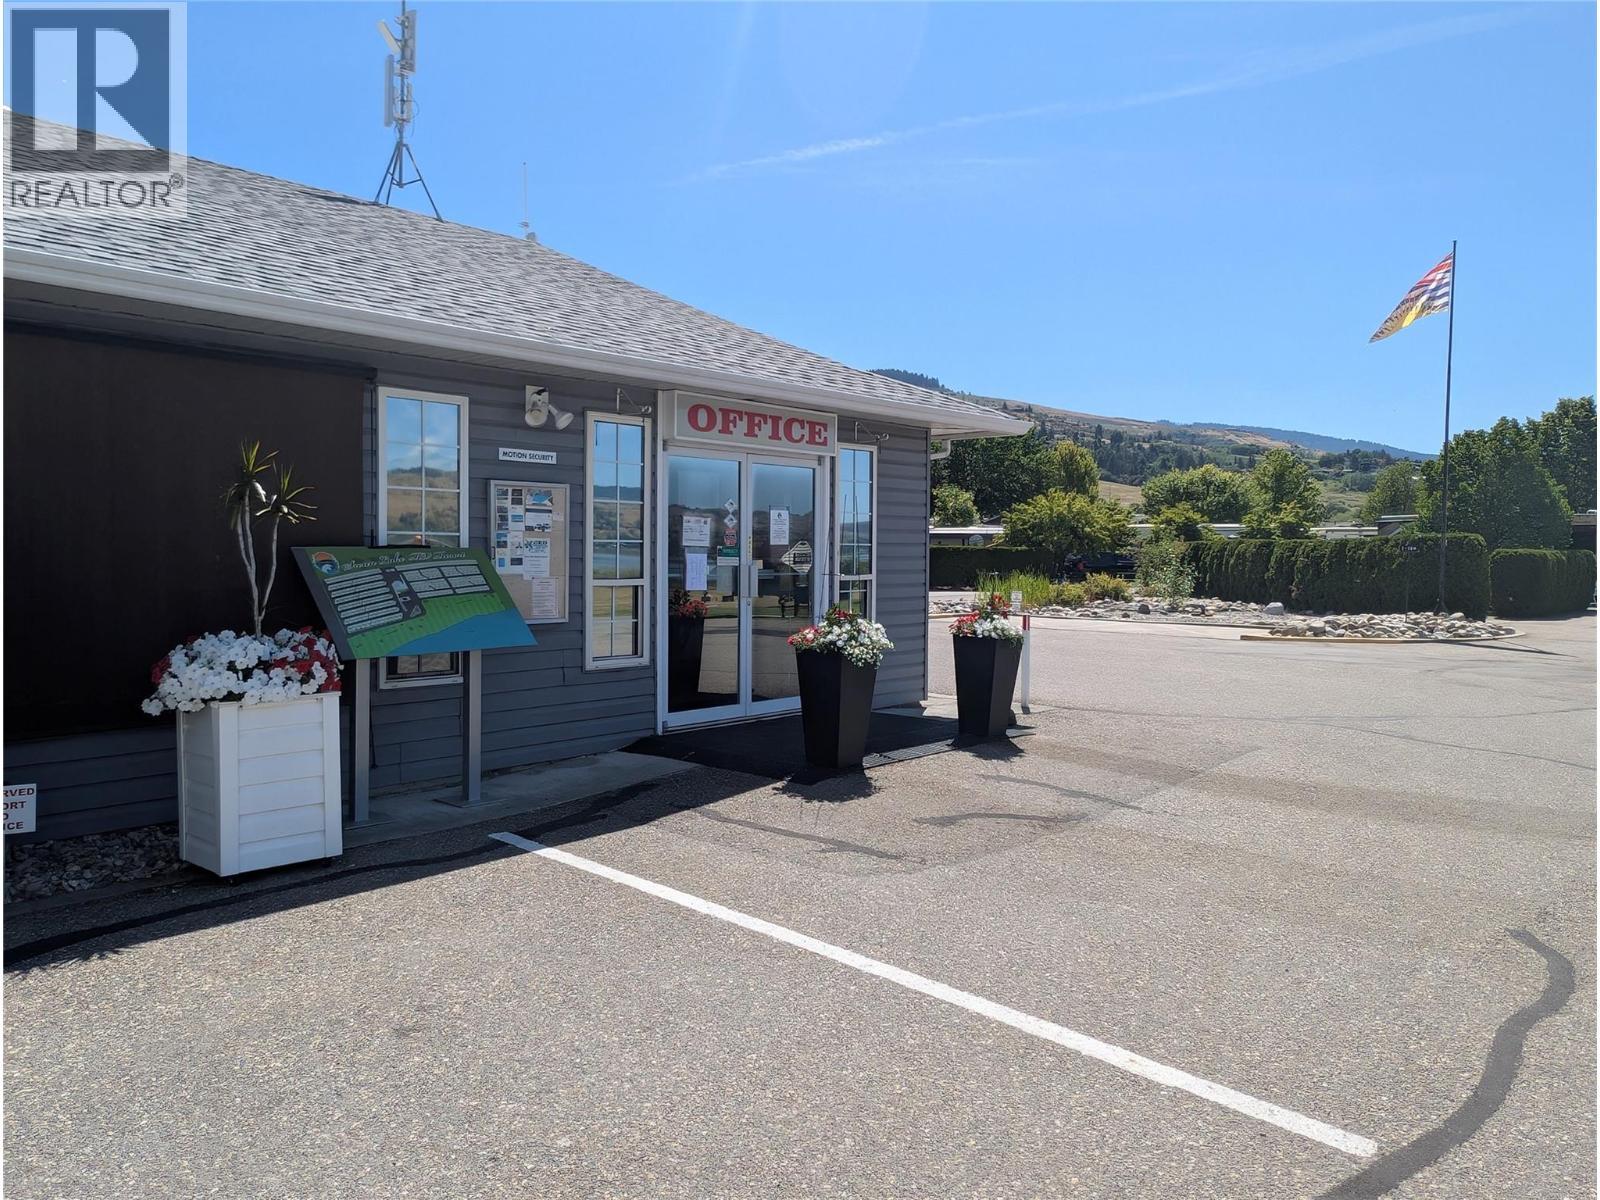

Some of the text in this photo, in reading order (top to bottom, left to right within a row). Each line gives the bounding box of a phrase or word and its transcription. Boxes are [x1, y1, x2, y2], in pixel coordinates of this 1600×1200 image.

[687, 403, 828, 447] OFFICE
[502, 451, 554, 461] MOTION SECURITY
